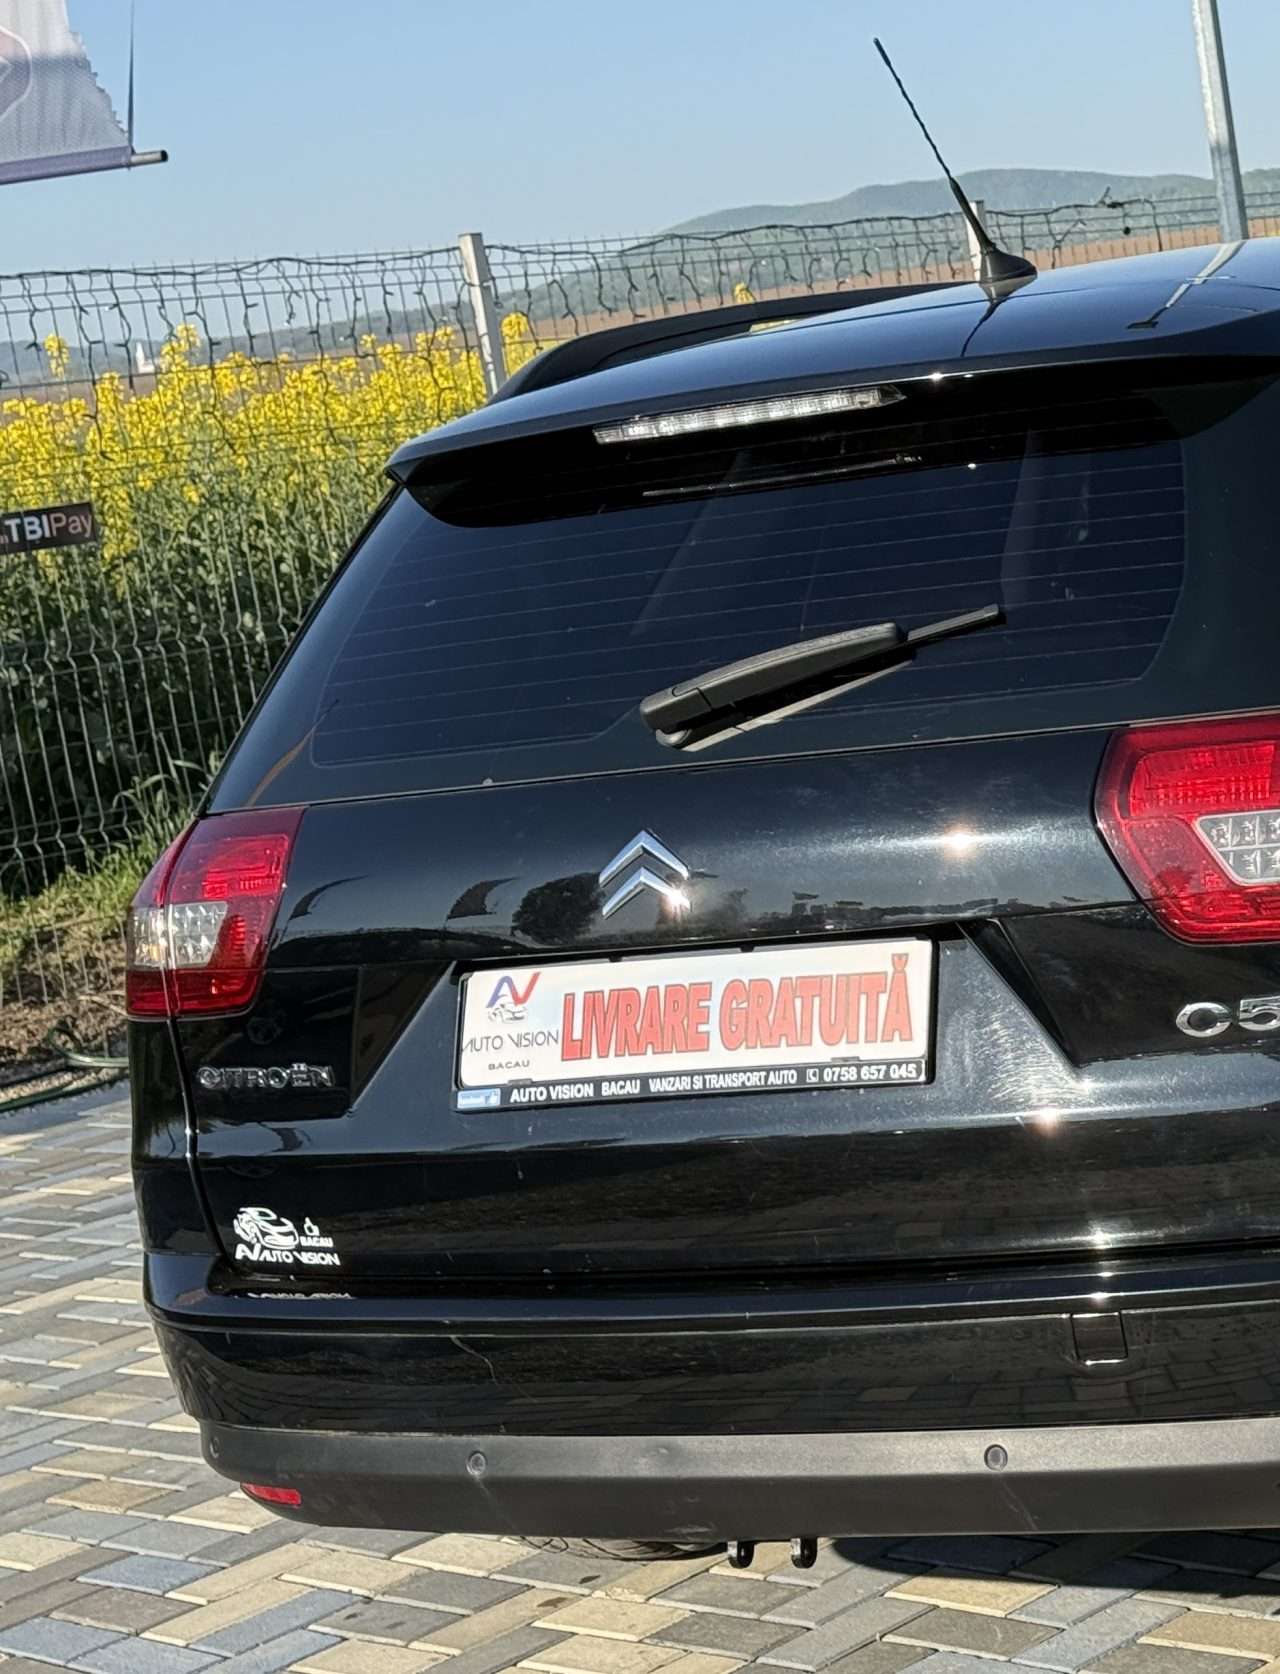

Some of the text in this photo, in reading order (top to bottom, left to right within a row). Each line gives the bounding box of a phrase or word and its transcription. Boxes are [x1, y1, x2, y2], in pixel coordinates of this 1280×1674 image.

[4, 513, 92, 543] TBIPay
[561, 953, 913, 1061] LIVRARE GRATUITĂ
[462, 1029, 560, 1054] AUTO VISION
[197, 1062, 335, 1090] CITROËN
[488, 1059, 531, 1071] BACAU
[510, 1063, 917, 1103] AUTO VISION BACAU VANZARI SI TRANSPORT AUTO 0758 657 045
[292, 1251, 341, 1265] VISION
